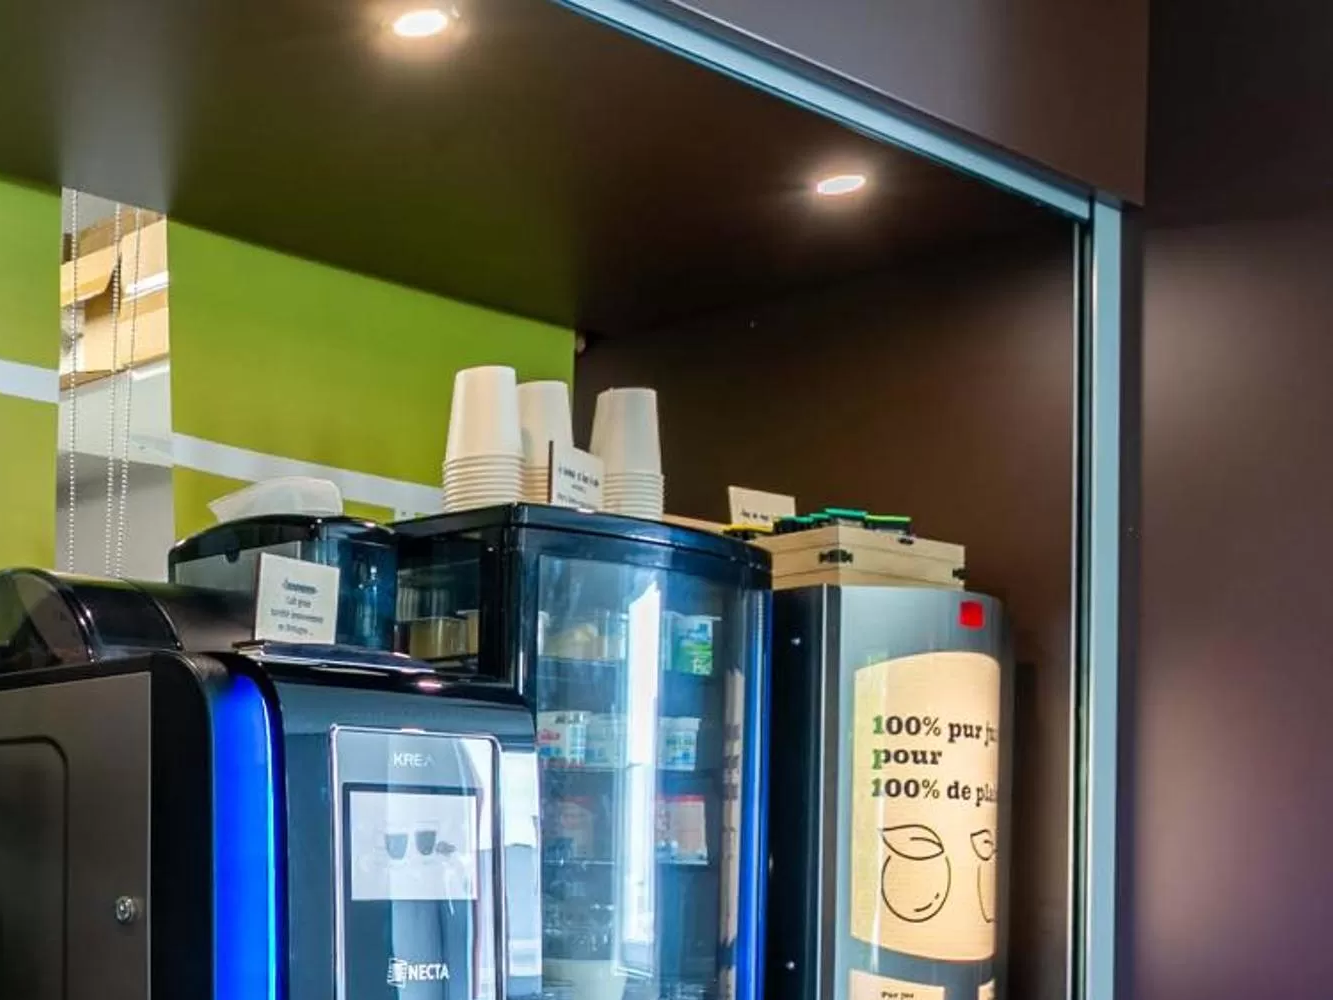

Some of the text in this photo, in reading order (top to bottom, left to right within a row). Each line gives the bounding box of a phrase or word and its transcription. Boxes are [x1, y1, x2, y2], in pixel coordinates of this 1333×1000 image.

[872, 715, 941, 737] 100%
[948, 721, 983, 743] pur
[872, 748, 942, 770] pour
[871, 778, 940, 799] 100%
[946, 780, 971, 801] de
[407, 963, 450, 982] NECTA
